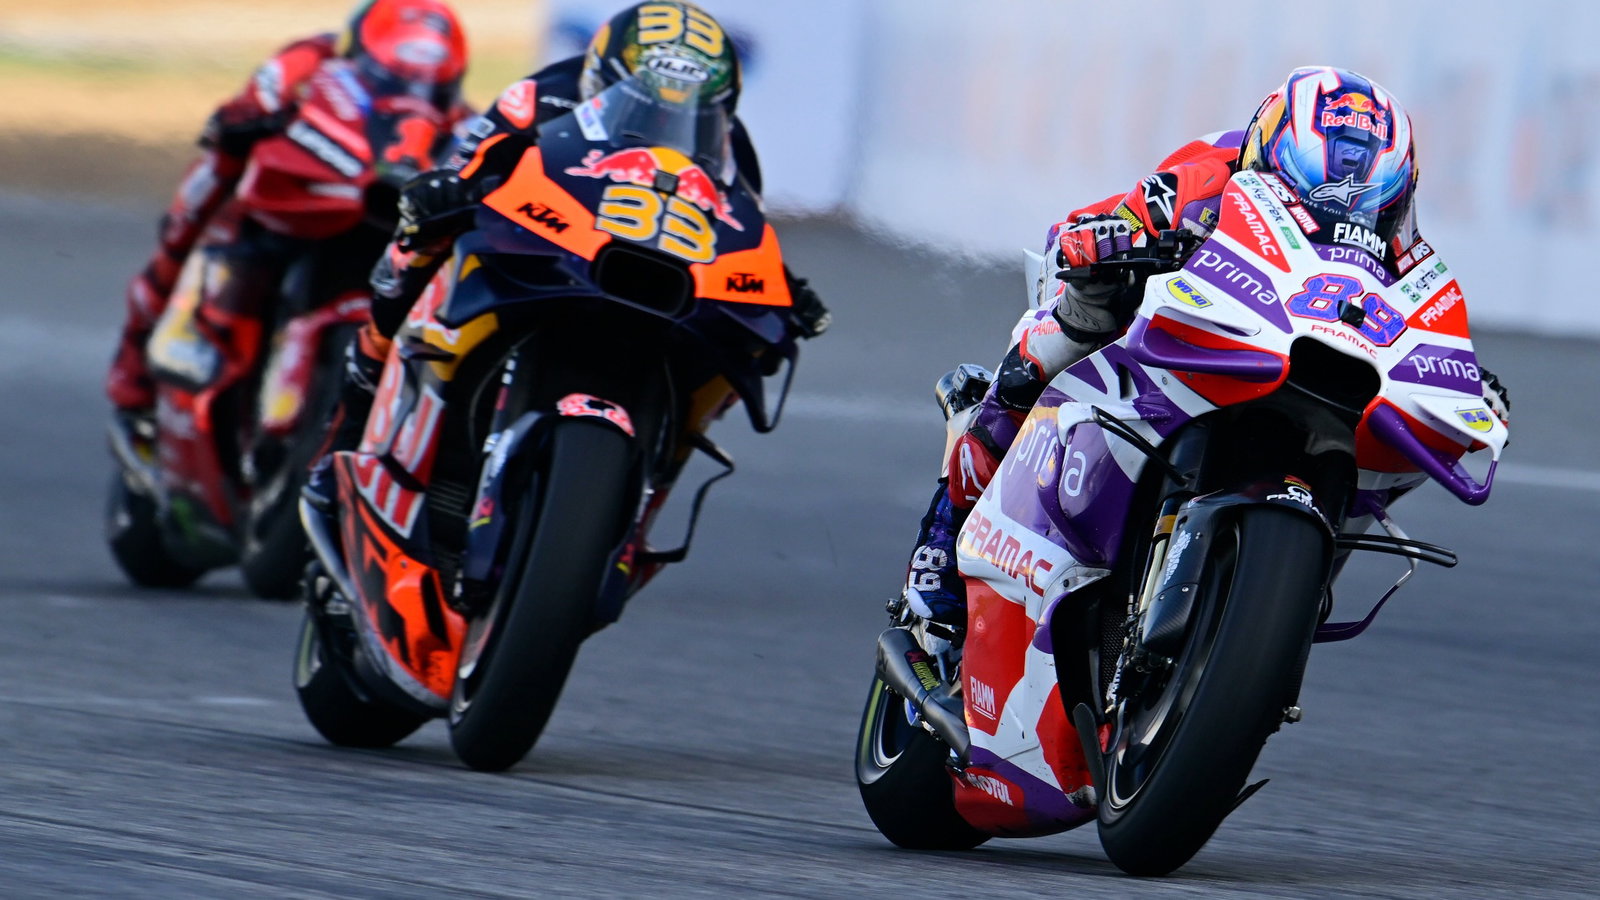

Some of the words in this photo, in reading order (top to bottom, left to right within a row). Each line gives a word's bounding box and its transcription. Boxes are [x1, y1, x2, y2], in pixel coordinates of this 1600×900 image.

[638, 5, 724, 58] 33
[1321, 111, 1356, 128] Red
[1359, 115, 1388, 140] Bull
[517, 202, 570, 234] KTM
[595, 185, 717, 264] 33
[1227, 192, 1278, 256] PRAMAC
[1289, 206, 1318, 233] MOTUL
[1333, 222, 1387, 259] FIAMM
[1192, 249, 1278, 306] prima
[1327, 247, 1386, 280] prima
[726, 273, 764, 293] KTM
[1173, 280, 1208, 306] WD-40
[1285, 273, 1408, 348] 89
[1419, 286, 1463, 327] PRAMAC
[1311, 324, 1379, 360] PRAMAC
[1408, 353, 1480, 382] prima
[965, 510, 1053, 598] PRAMAC
[970, 675, 996, 715] FIAMM
